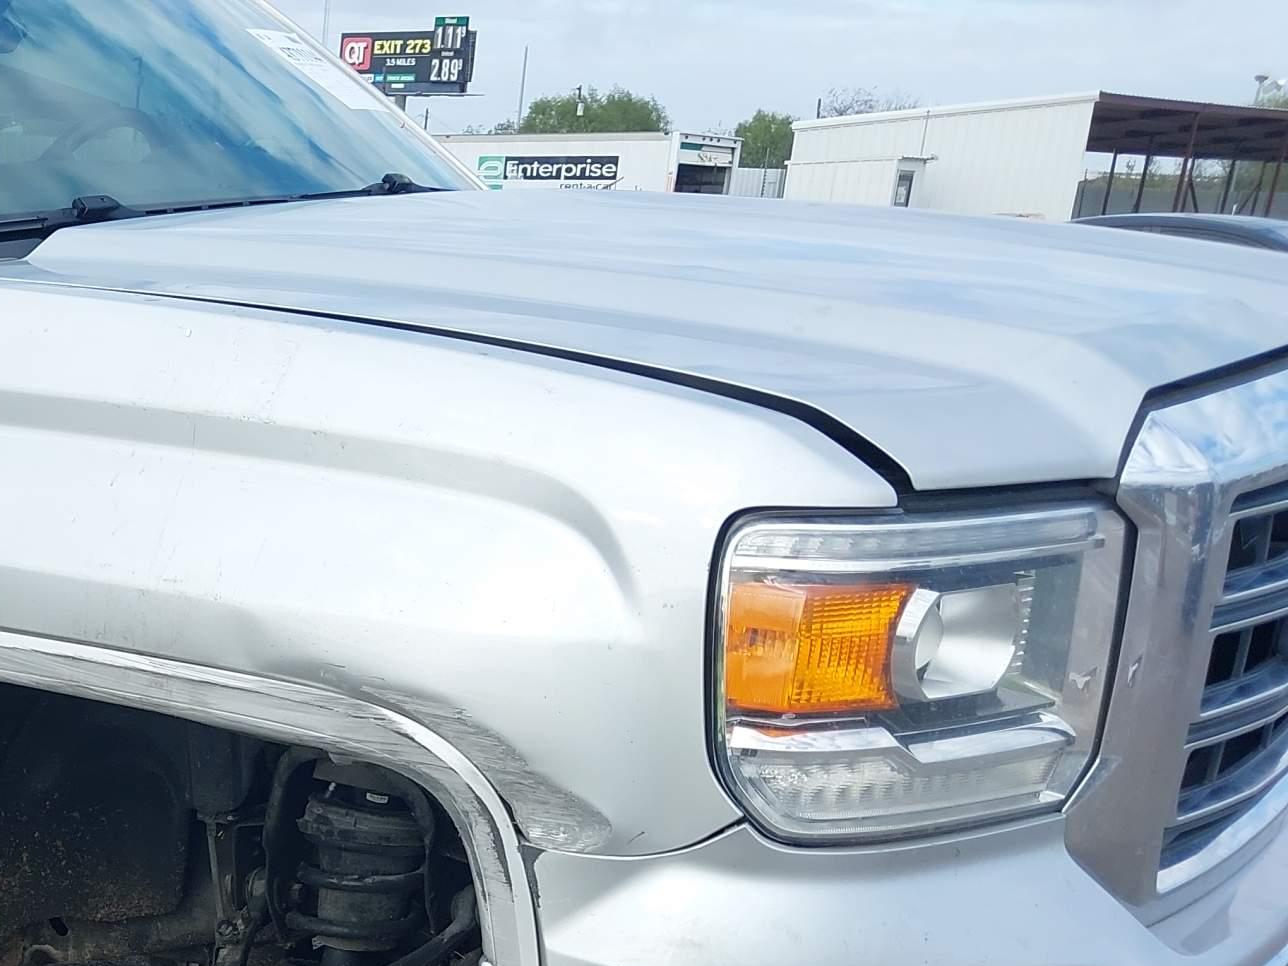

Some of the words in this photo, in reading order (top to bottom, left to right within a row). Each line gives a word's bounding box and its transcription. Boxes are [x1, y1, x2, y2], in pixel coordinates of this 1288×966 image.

[345, 42, 367, 65] QT
[374, 40, 403, 54] EXIT
[405, 40, 431, 53] 273
[505, 159, 617, 180] Enterprise
